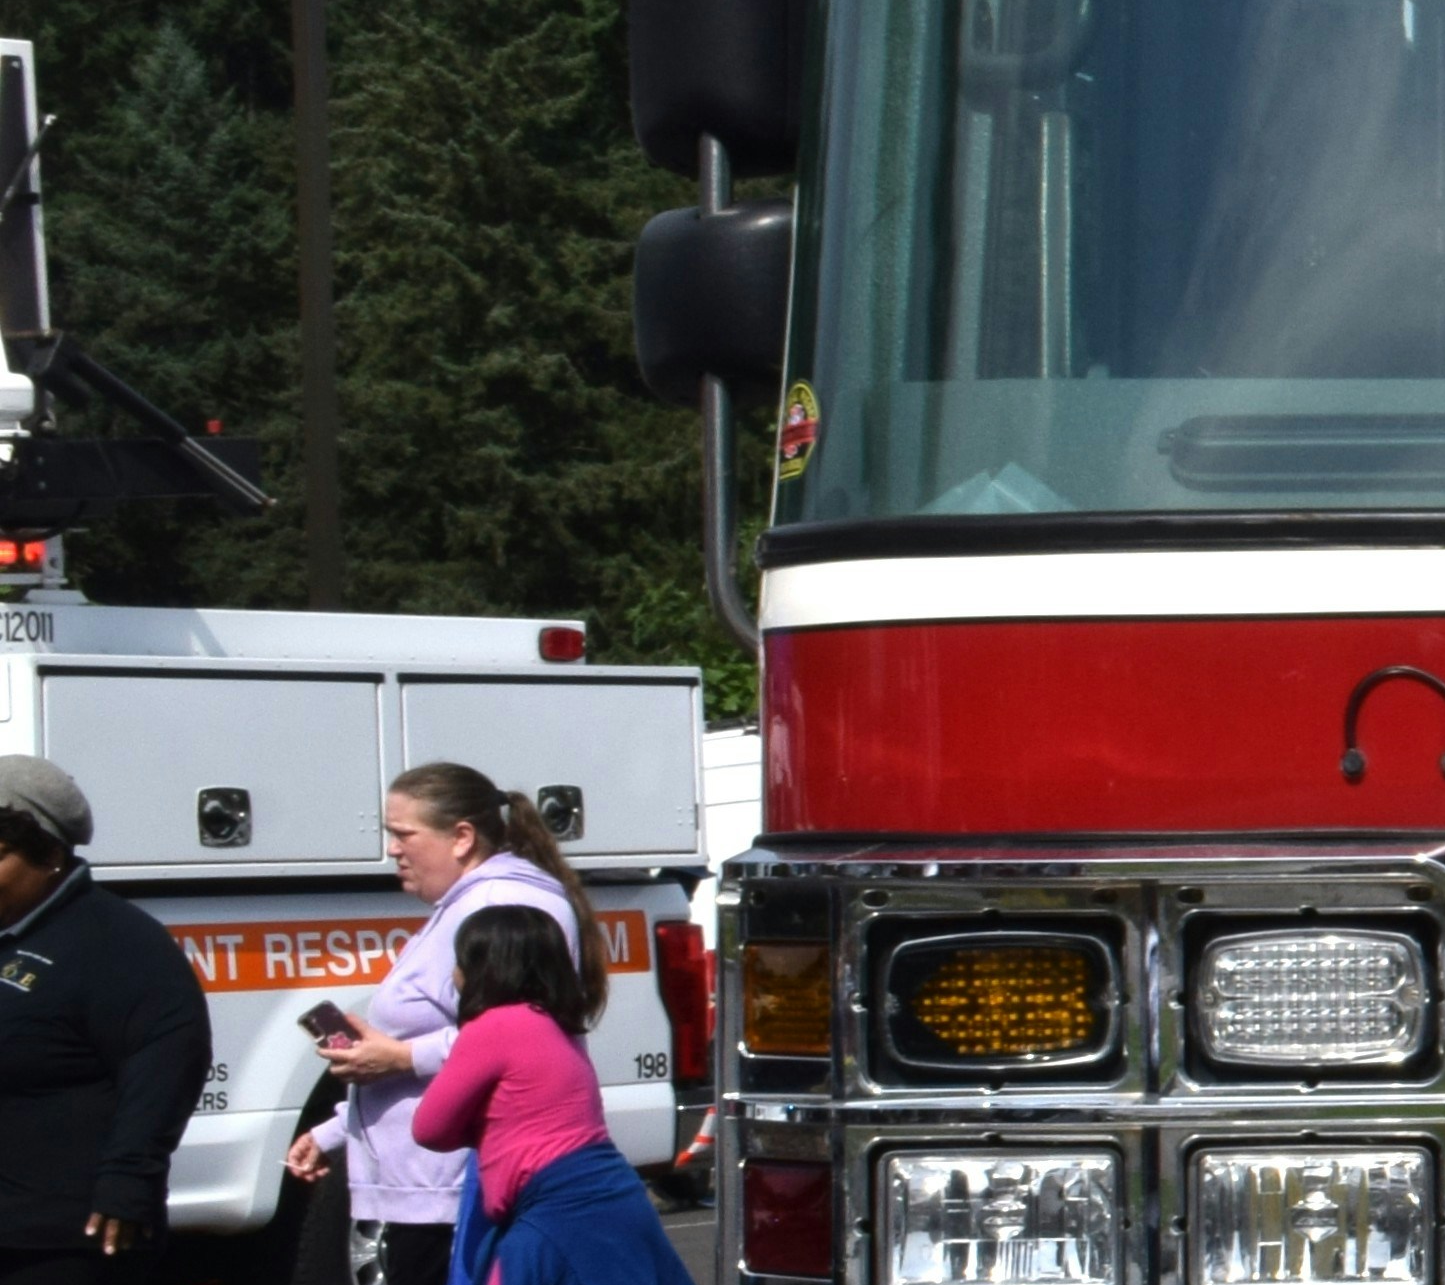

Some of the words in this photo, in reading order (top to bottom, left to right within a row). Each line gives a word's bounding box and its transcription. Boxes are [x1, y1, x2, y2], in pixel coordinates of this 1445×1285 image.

[0, 610, 54, 643] 12011
[264, 927, 416, 979] RESPO
[634, 1052, 668, 1079] 198
